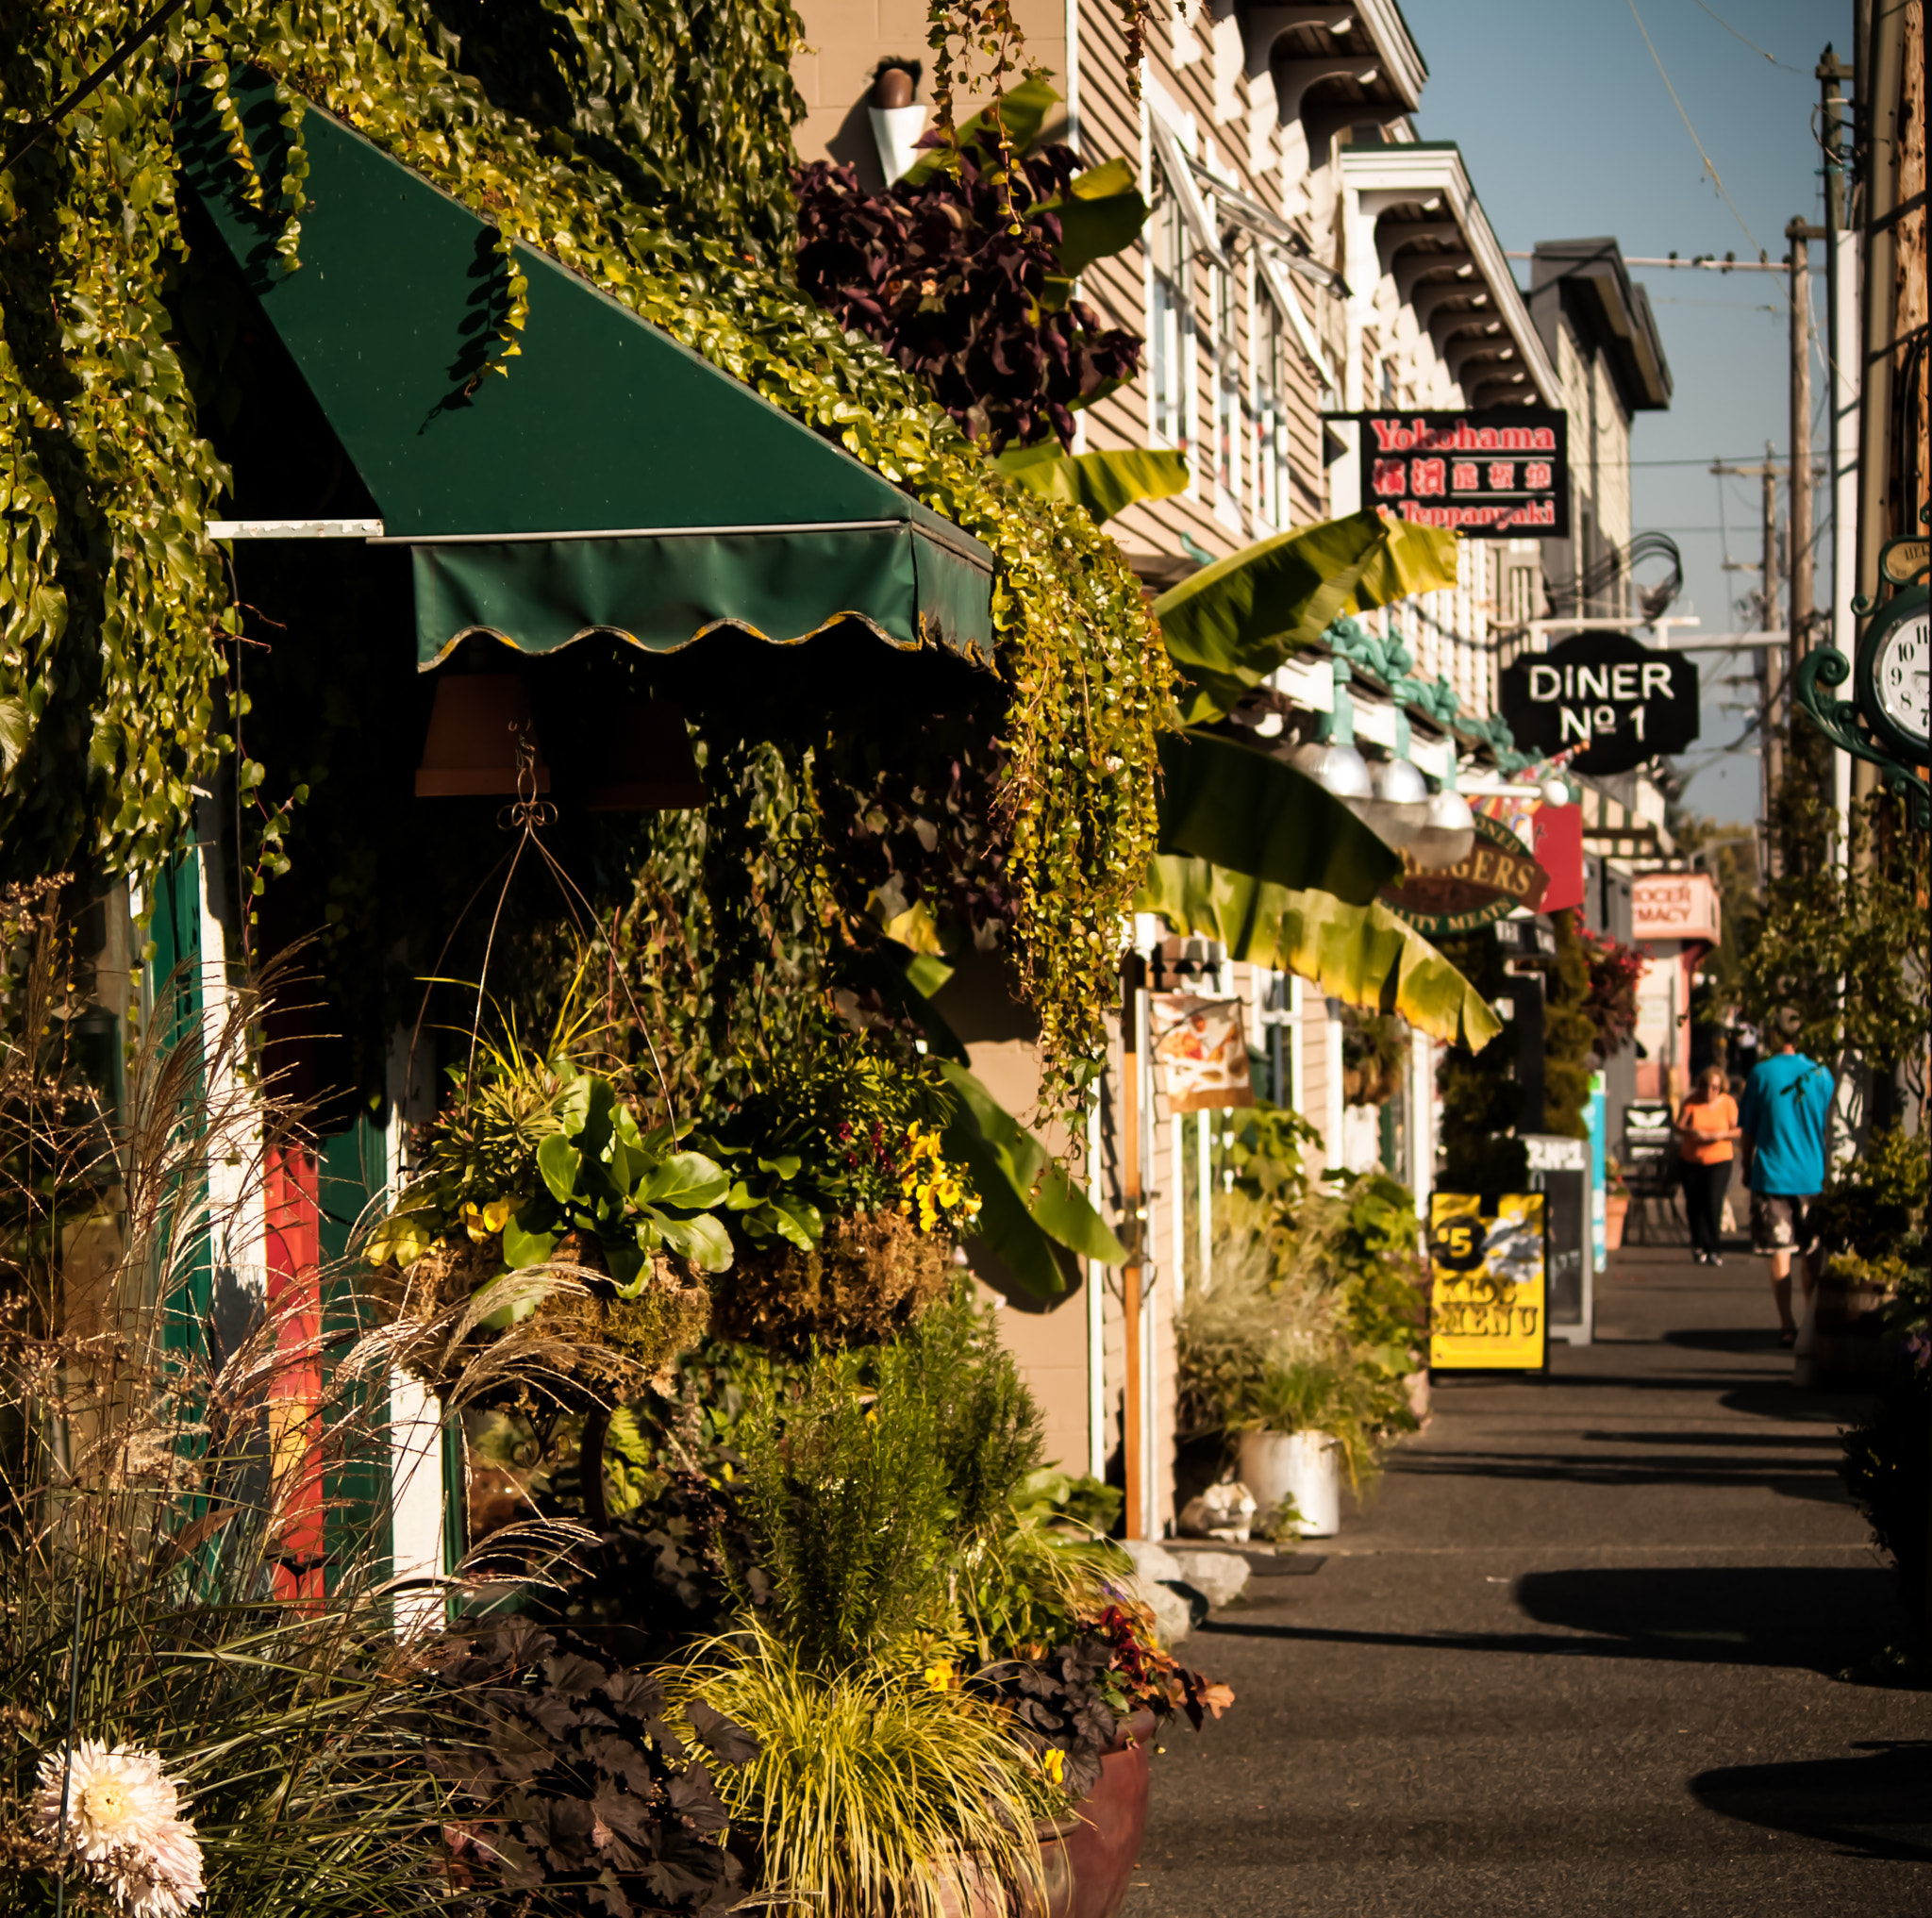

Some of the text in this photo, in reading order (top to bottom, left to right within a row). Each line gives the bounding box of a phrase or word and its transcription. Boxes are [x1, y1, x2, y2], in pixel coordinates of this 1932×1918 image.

[1371, 418, 1556, 451] Yokohama
[1398, 499, 1555, 531] Teppanyaki
[1898, 642, 1915, 662] 10
[1529, 662, 1675, 702] DINER
[1890, 667, 1903, 687] 9
[1900, 690, 1912, 709] 8
[1629, 706, 1645, 742] 1
[1447, 897, 1512, 930] MEATS
[1438, 1305, 1539, 1337] MENU
